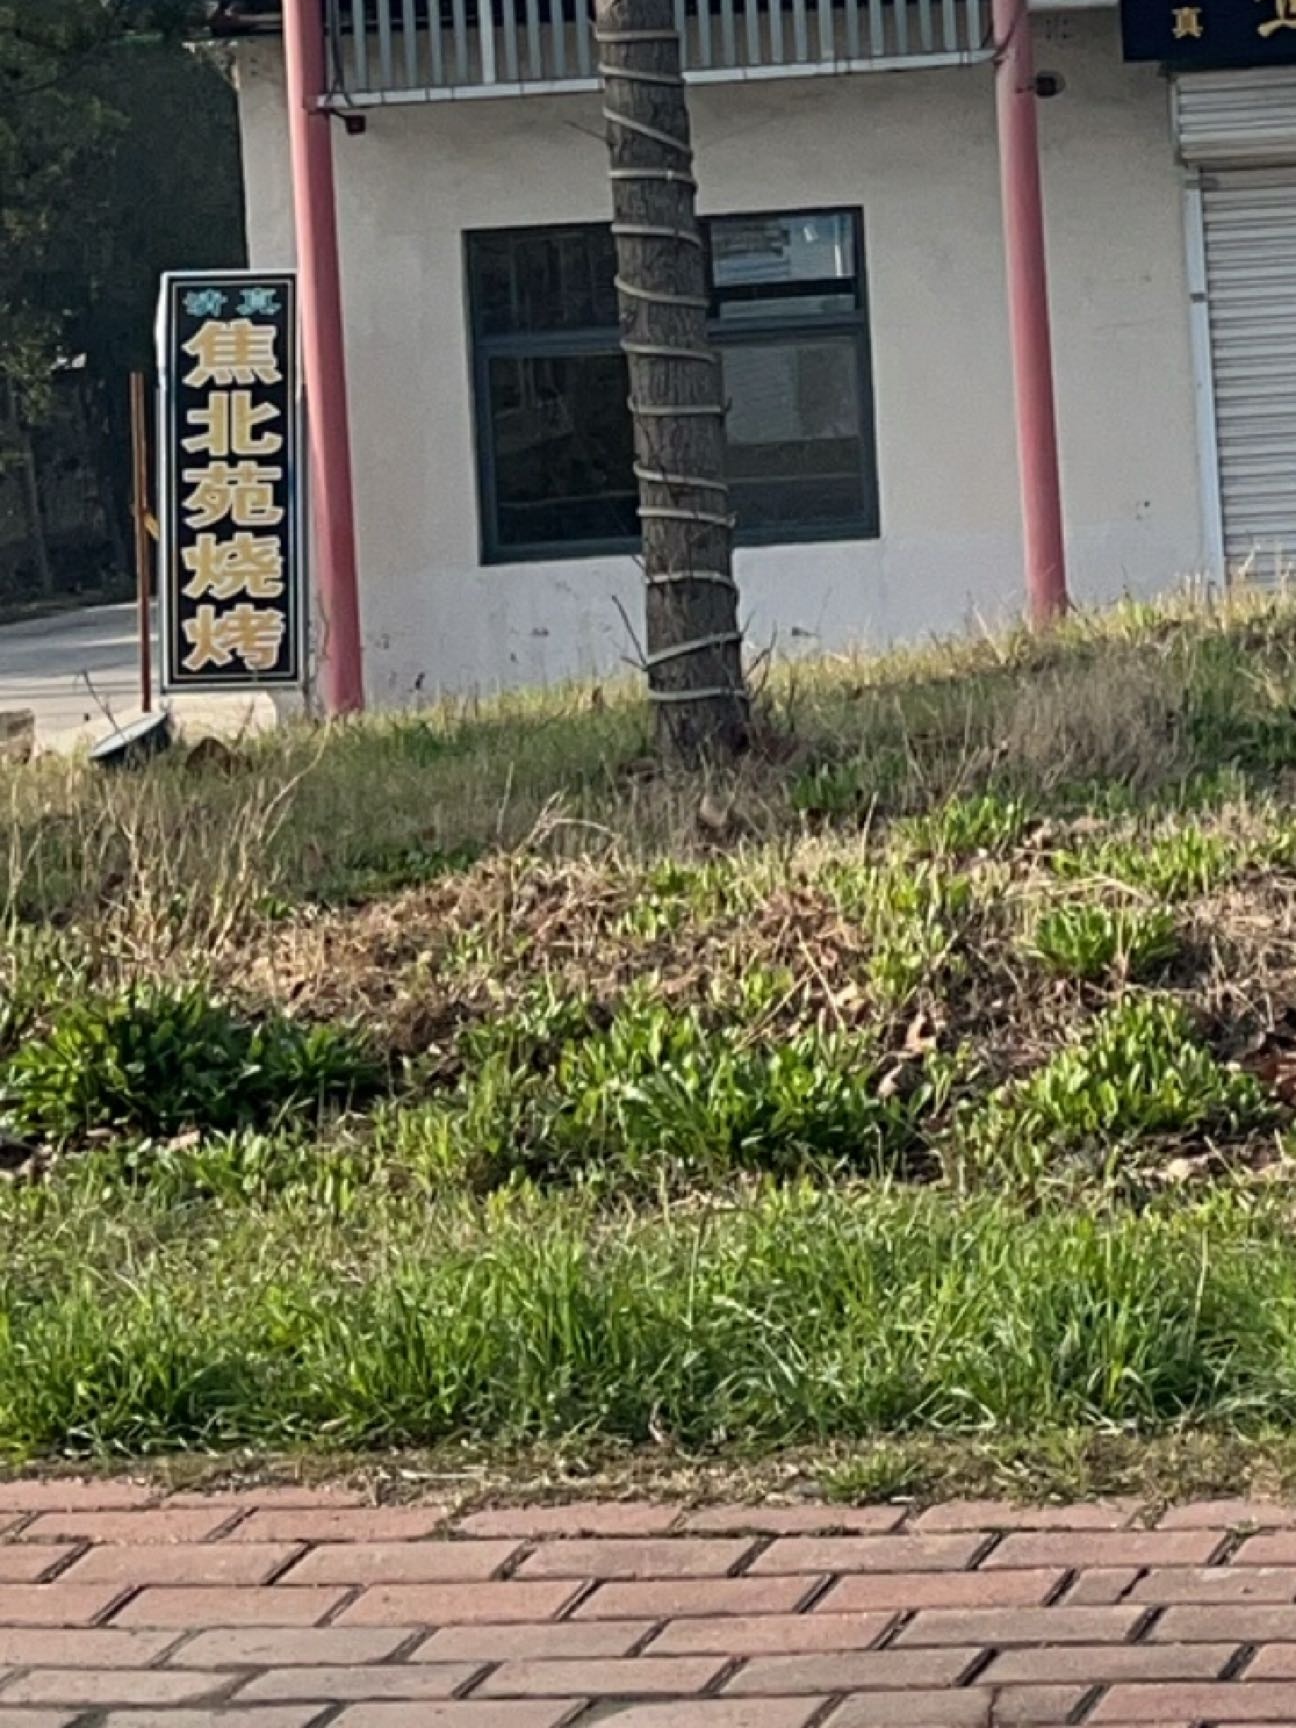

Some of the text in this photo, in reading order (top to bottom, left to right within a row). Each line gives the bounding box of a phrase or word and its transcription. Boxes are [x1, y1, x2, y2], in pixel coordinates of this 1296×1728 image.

[181, 318, 284, 672] 焦北苑烧烤
